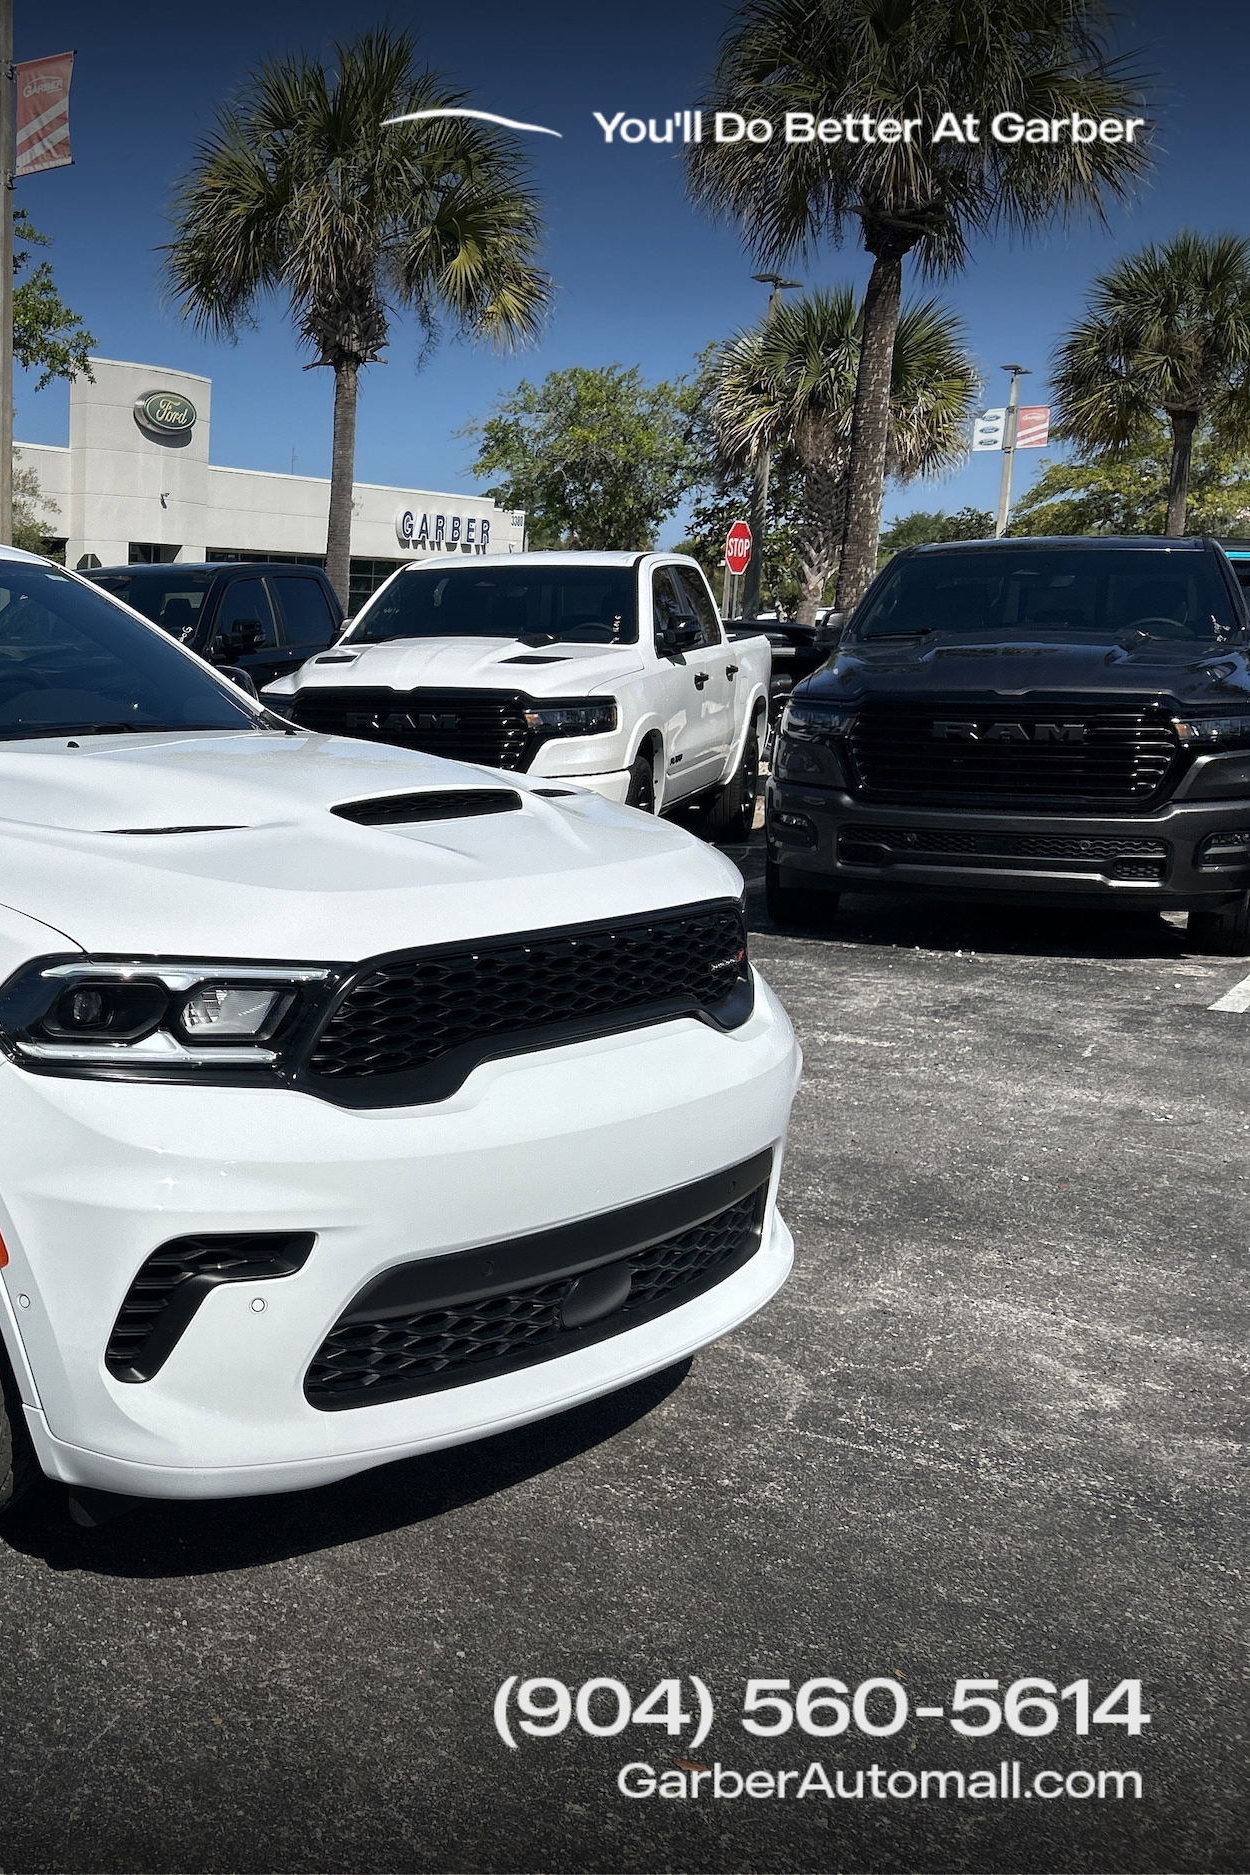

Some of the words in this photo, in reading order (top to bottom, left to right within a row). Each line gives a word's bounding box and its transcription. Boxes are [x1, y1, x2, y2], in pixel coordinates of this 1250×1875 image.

[156, 399, 188, 424] Ford
[400, 510, 491, 544] GARBER
[727, 537, 751, 558] STOP
[346, 712, 461, 730] RAM
[932, 720, 1087, 742] RAM
